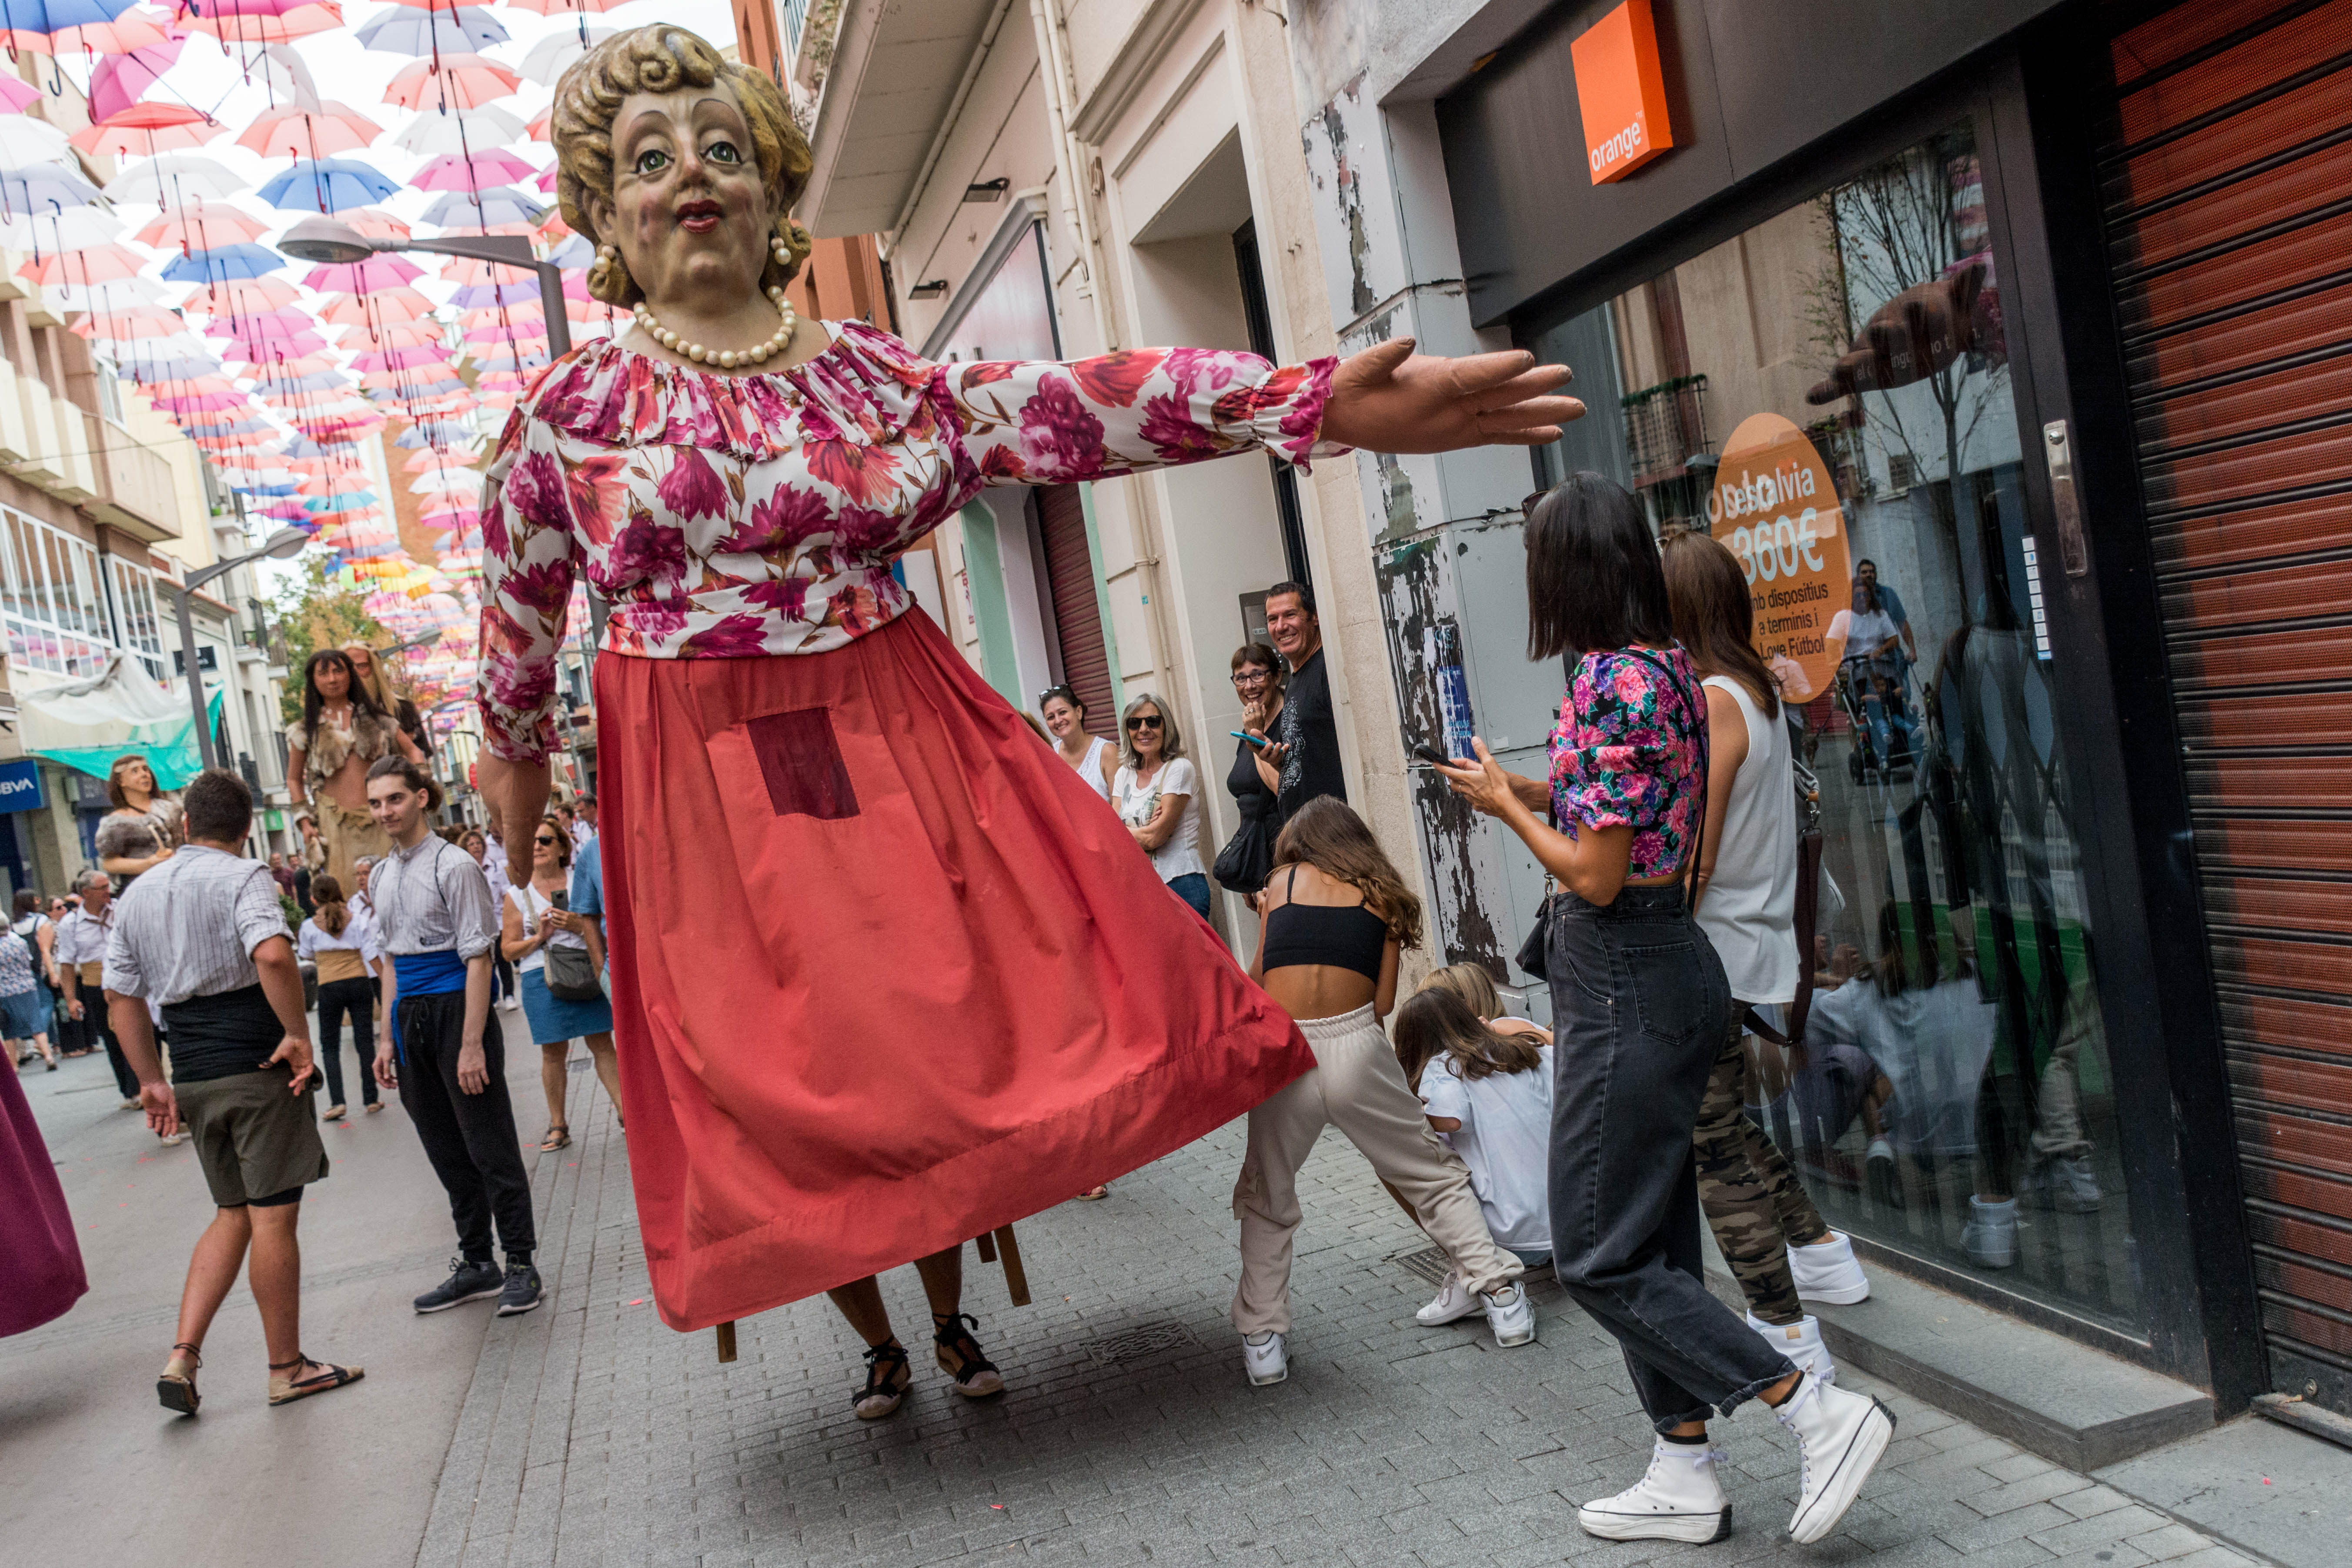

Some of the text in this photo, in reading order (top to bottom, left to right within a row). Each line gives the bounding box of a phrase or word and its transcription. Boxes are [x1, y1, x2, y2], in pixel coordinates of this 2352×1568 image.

[1591, 122, 1641, 172] orange
[1734, 462, 1815, 514] estalvia
[1733, 507, 1824, 586] 360€
[1768, 582, 1828, 609] dispositius
[1758, 607, 1819, 635] a terminis i
[1760, 633, 1825, 660] Love Fútbol
[0, 777, 35, 795] BVA
